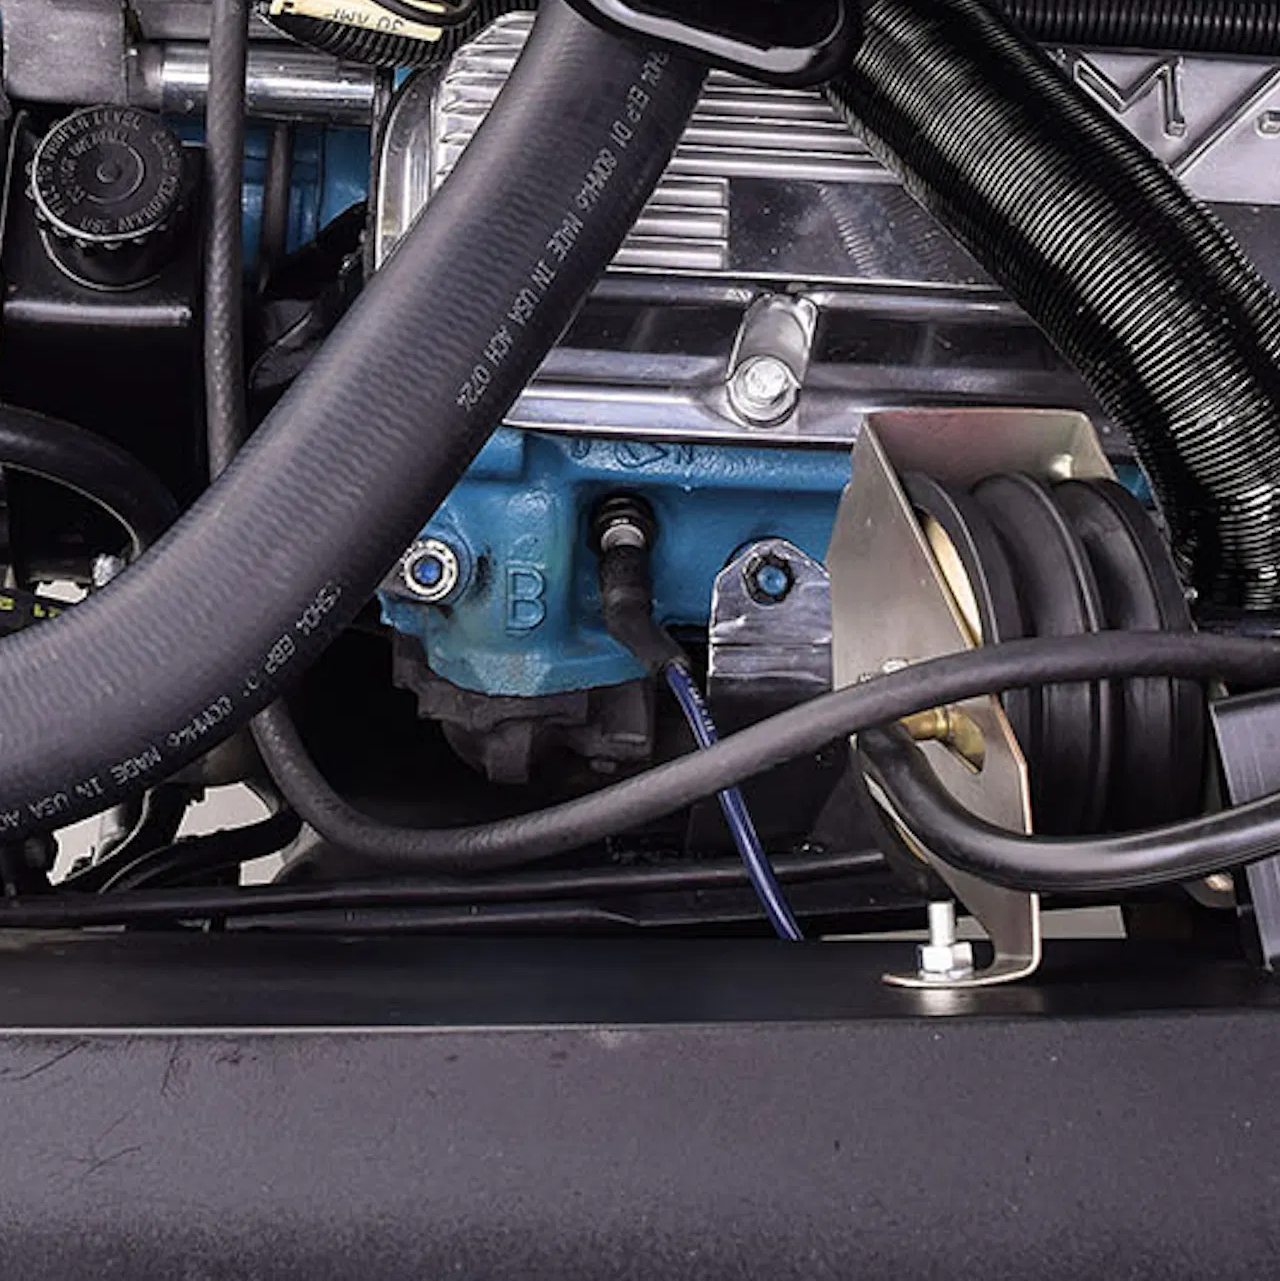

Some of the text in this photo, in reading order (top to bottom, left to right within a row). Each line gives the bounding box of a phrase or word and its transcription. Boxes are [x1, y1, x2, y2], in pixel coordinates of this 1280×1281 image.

[545, 211, 584, 262] MADE
[528, 258, 556, 291] IN
[506, 287, 540, 326] USA
[505, 563, 547, 637] B
[110, 745, 162, 785] MADE
[27, 787, 69, 819] USA
[75, 776, 104, 798] IN
